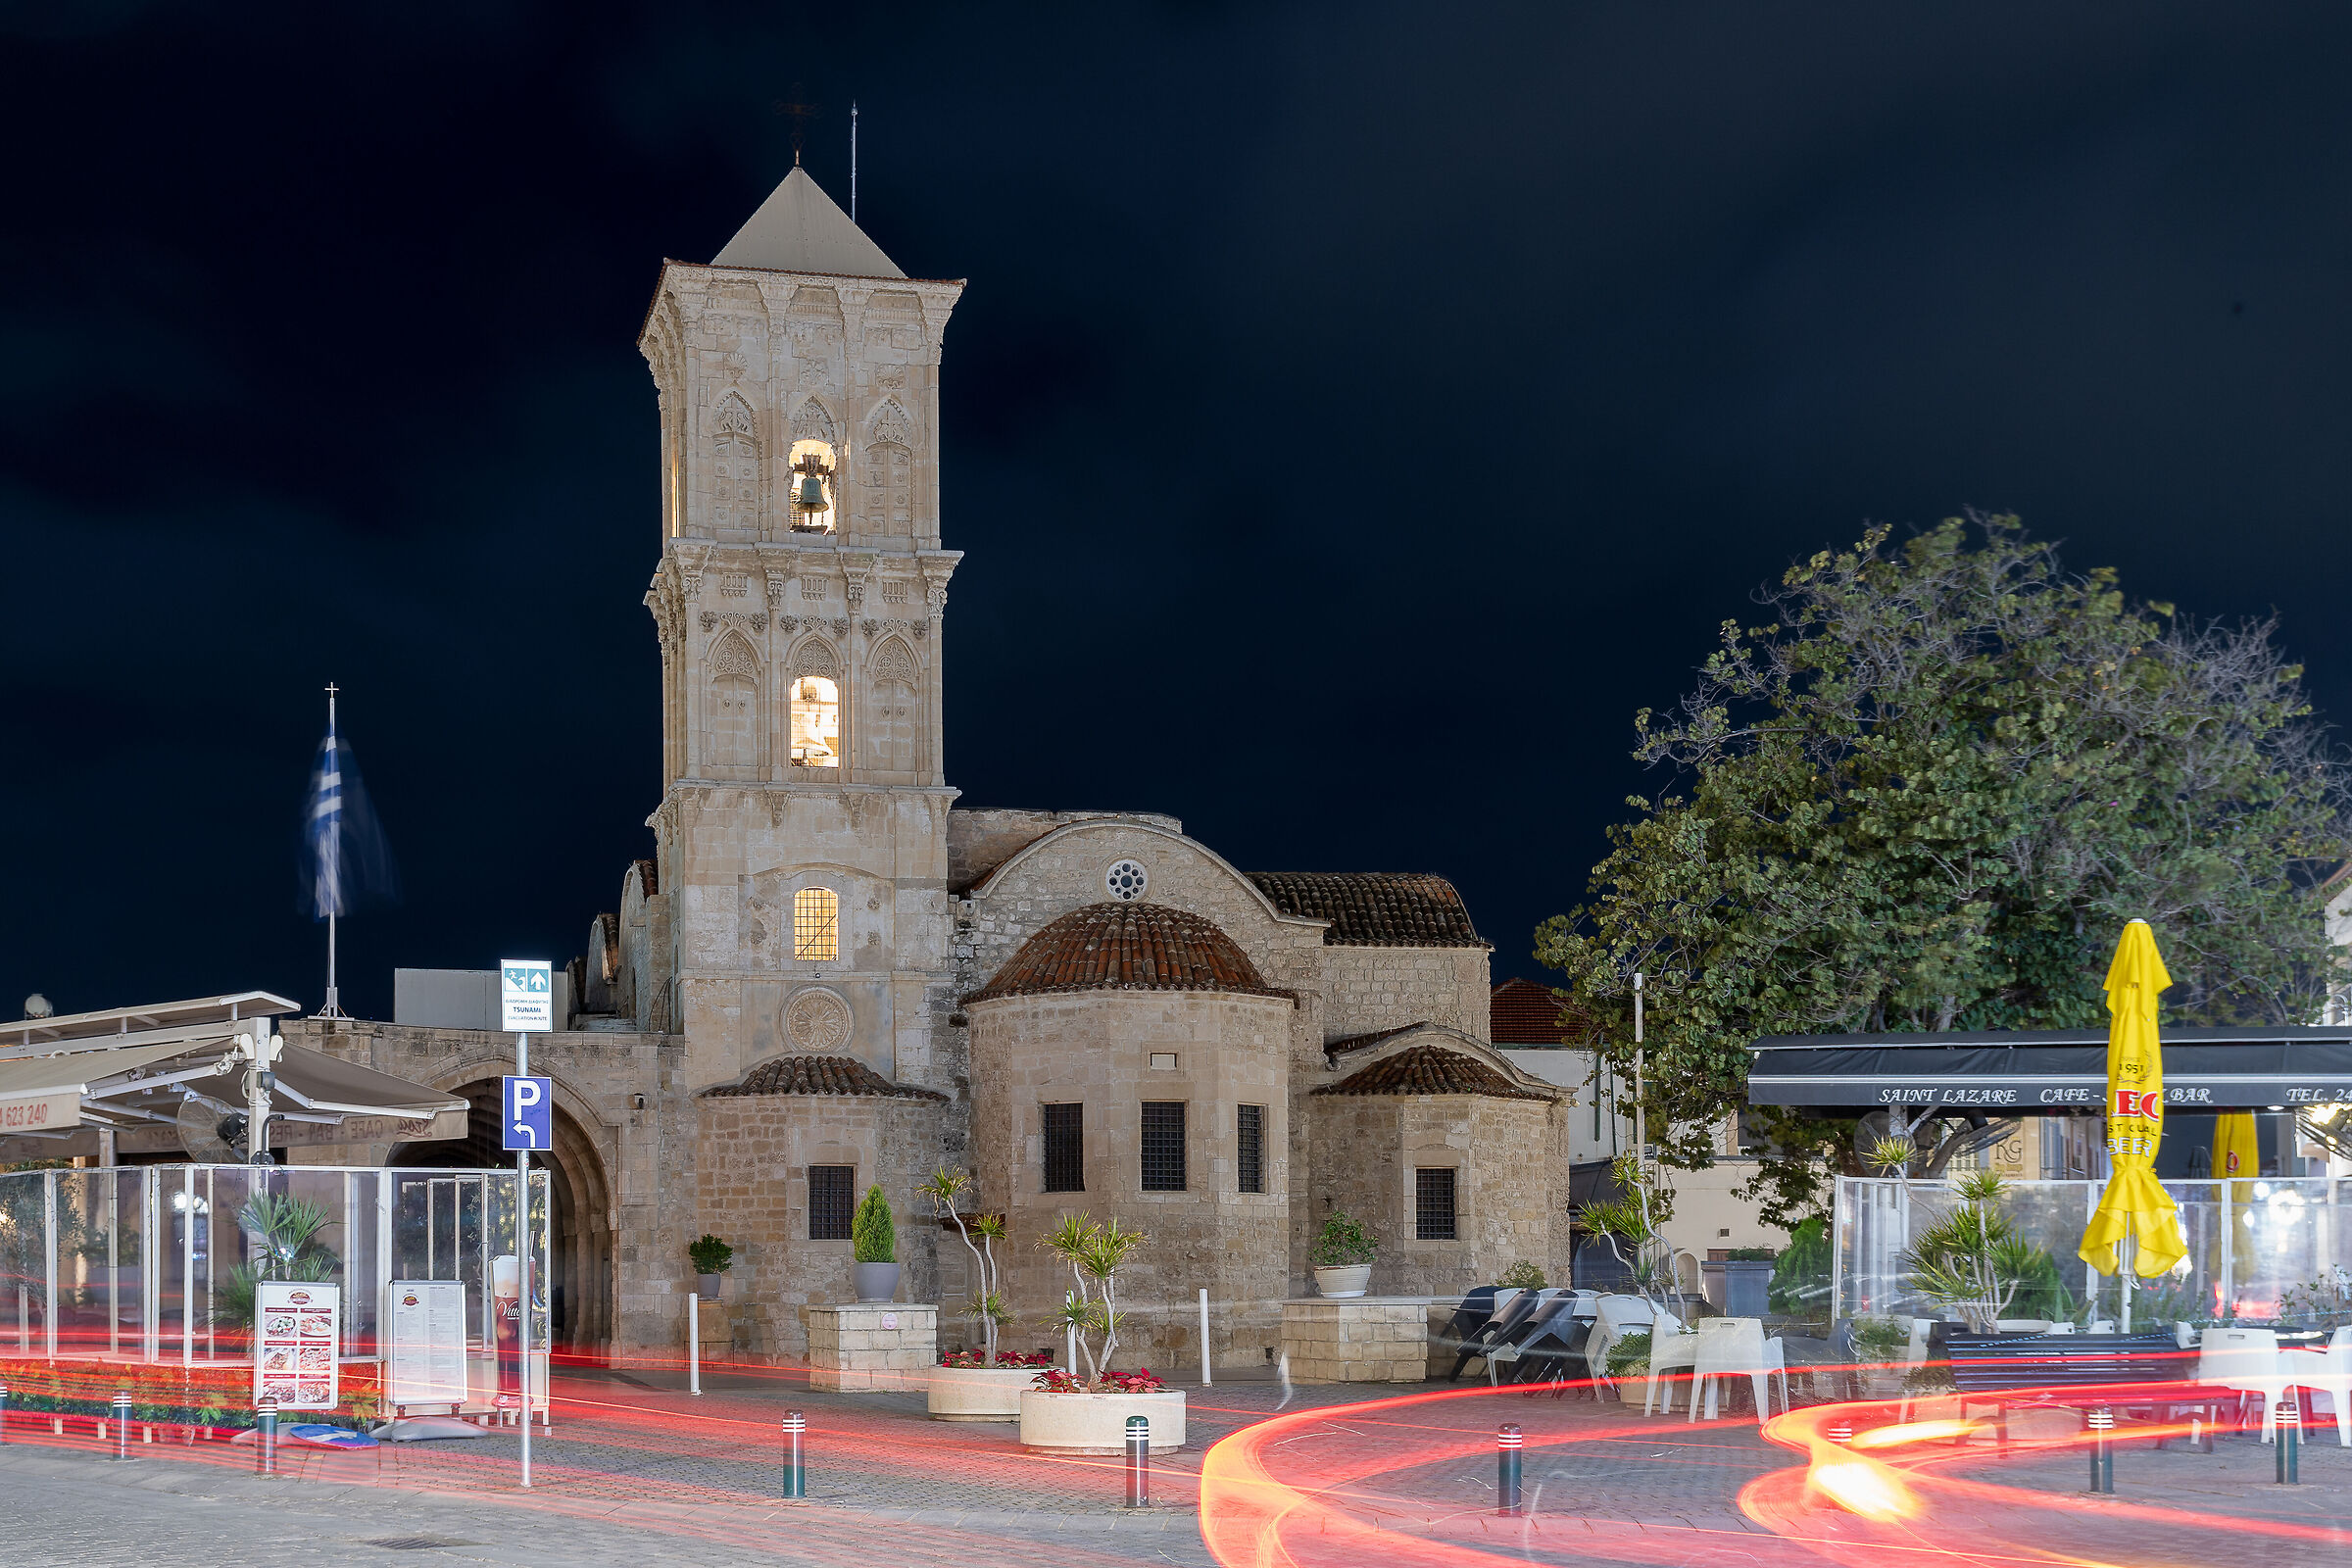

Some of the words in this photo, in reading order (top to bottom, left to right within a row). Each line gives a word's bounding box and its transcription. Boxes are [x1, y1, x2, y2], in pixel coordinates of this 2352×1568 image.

[514, 1080, 541, 1120] P
[1879, 1088, 1937, 1102] SAINT
[1941, 1089, 2017, 1103] LAZARE
[2170, 1088, 2214, 1103] BAR
[6, 1105, 24, 1127] 623
[27, 1102, 47, 1125] 240
[2107, 1137, 2153, 1157] BEER
